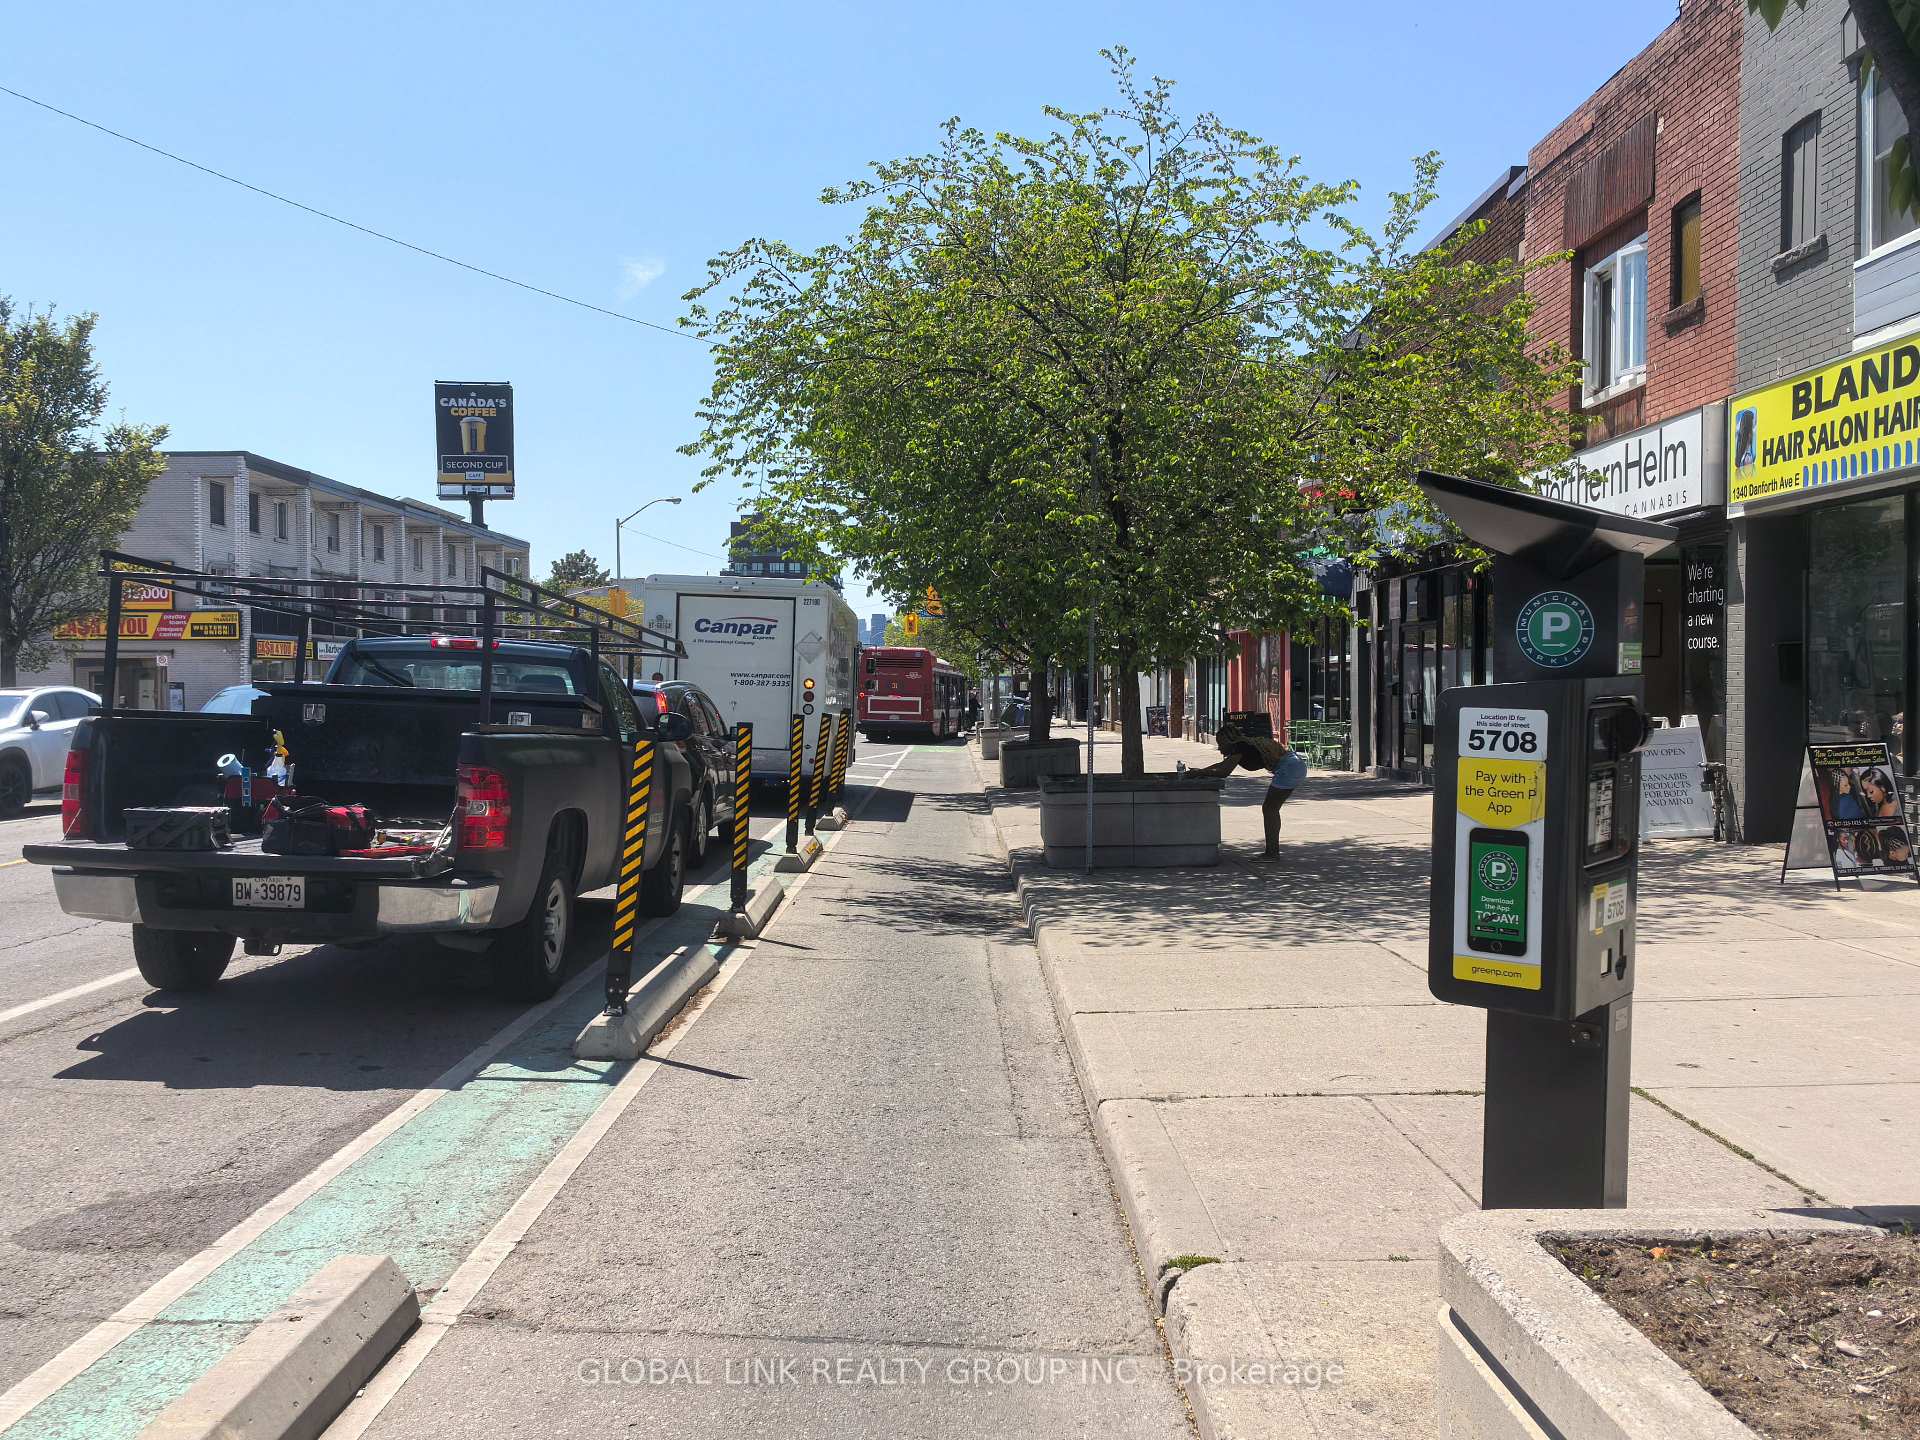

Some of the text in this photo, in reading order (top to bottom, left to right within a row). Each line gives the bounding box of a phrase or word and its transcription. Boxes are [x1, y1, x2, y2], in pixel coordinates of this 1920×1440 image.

[440, 397, 507, 408] CANADA'S
[450, 407, 497, 417] COFFEE
[1762, 430, 1804, 467] HAIR
[1808, 410, 1868, 456] SALON
[446, 461, 504, 469] SECOND CUP
[1733, 473, 1800, 501] 1340 Danforth Ave E
[1624, 489, 1688, 517] CANNABIS
[1687, 563, 1713, 581] We're
[1687, 585, 1724, 606] charting
[1520, 595, 1590, 627] MUNICIPAL
[1542, 611, 1571, 640] P
[1687, 613, 1714, 627] a new
[694, 618, 777, 637] Canpar
[1521, 636, 1589, 664] PARKING
[1687, 636, 1720, 650] course.
[730, 672, 791, 680] www.canpar.com
[733, 680, 790, 688] 1-800-387-9335
[1480, 713, 1507, 721] Location
[1468, 729, 1538, 754] 5708
[1641, 747, 1687, 758] OW OPEN
[1476, 770, 1526, 784] Pay with
[1641, 772, 1688, 782] CANNABIS
[1465, 785, 1537, 799] the Green P
[1643, 780, 1692, 791] PRODUCTS
[1644, 788, 1688, 798] FOR BODY
[1487, 801, 1513, 815] App
[1646, 797, 1694, 807] AND MIND
[1491, 861, 1506, 877] P
[236, 882, 301, 902] BW 39879
[1481, 895, 1514, 905] Download
[1484, 903, 1496, 911] the
[1607, 900, 1625, 919] 5708
[1471, 966, 1522, 978] greenp.com
